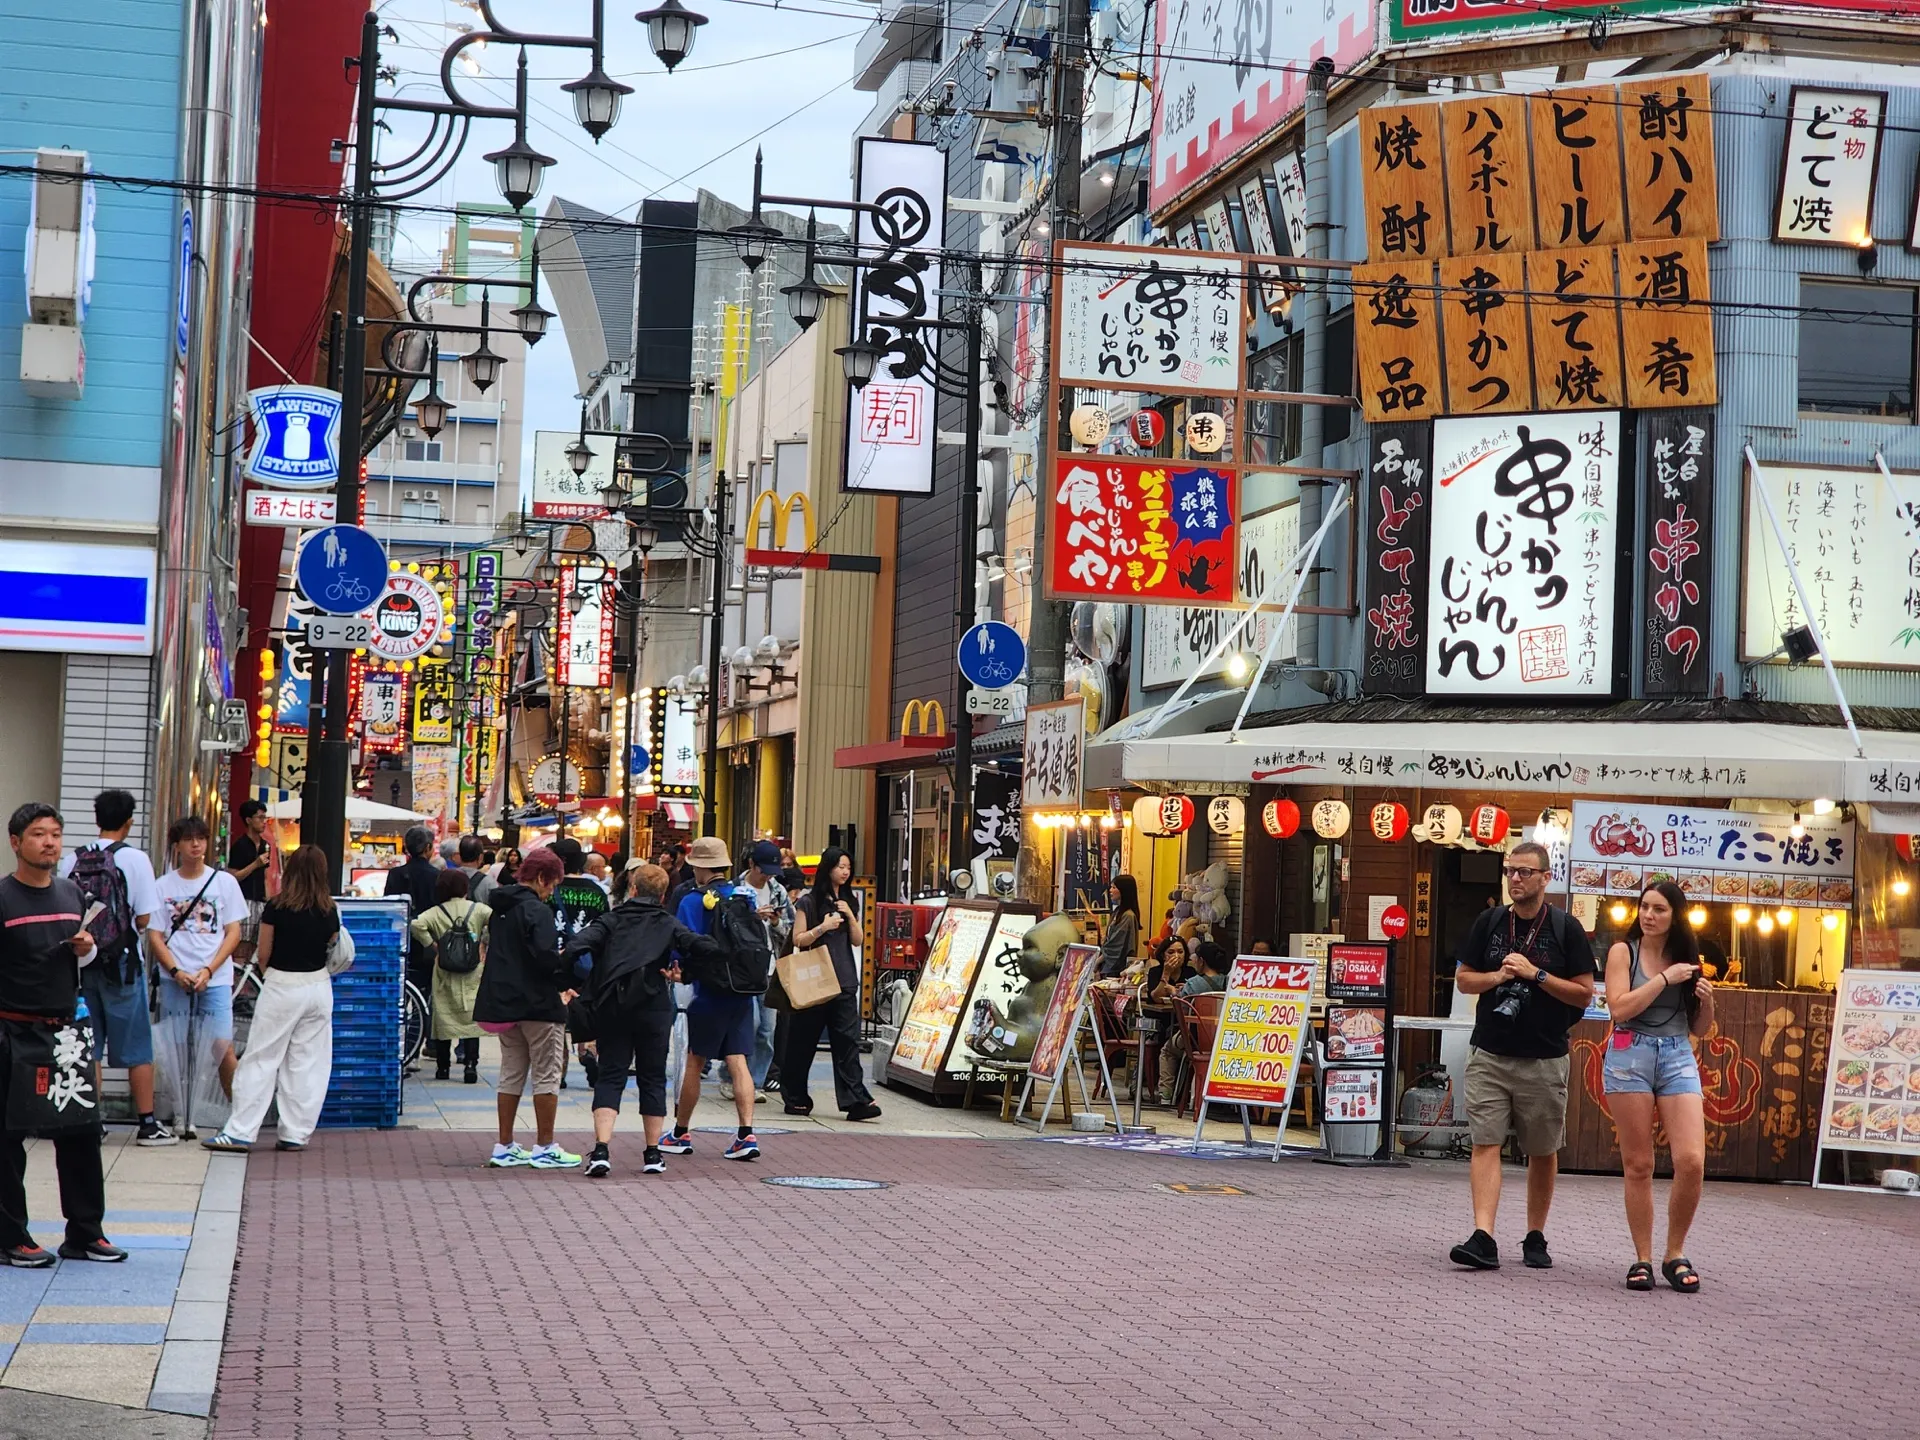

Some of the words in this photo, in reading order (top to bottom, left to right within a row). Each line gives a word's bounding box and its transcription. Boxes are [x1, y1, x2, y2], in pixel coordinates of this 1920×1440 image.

[1843, 107, 1868, 159] 名物
[1374, 115, 1431, 254] 焼酎
[1463, 107, 1513, 251] ハイボール
[1553, 96, 1605, 245] ビール
[1639, 87, 1694, 236] 酎ハイ
[1789, 105, 1844, 233] どて焼
[1123, 301, 1149, 363] じゃん
[1135, 260, 1188, 373] 串かつ
[1207, 267, 1235, 354] 味自慢
[1552, 259, 1608, 405] どて焼
[1635, 251, 1694, 396] 酒肴
[1098, 313, 1136, 378] じゃん
[1369, 273, 1427, 413] 逸品
[1460, 267, 1511, 410] 串かつ
[264, 399, 335, 417] LAWSON
[867, 388, 915, 439] 寿司
[1192, 416, 1217, 448] 串かつ
[261, 458, 330, 473] STATION
[1373, 438, 1424, 487] 名物
[1578, 421, 1613, 508] 味自慢
[1679, 425, 1706, 483] 屋台
[1106, 467, 1137, 557] じゃんじゃん
[1180, 492, 1200, 529] 求ム
[1196, 477, 1218, 529] 挑戦者
[1494, 425, 1574, 610] 串かつ
[1787, 481, 1801, 533] ほたて
[1817, 481, 1836, 518] 海老
[1851, 484, 1867, 565] じゃがいも
[1138, 468, 1170, 588] ゲテモノ
[1818, 528, 1835, 556] いか
[1127, 560, 1145, 592] 串も
[1368, 485, 1423, 651] どて焼
[1476, 510, 1518, 635] じゃん
[1650, 504, 1701, 675] 串かつ
[380, 614, 419, 632] KING
[1437, 555, 1506, 681] じゃん
[1848, 576, 1865, 629] 玉ねぎ
[313, 625, 368, 642] 9-22
[377, 637, 420, 654] OSAKA
[1646, 614, 1667, 684] 味自慢
[377, 684, 394, 723] 串カツ
[969, 696, 1010, 711] 9-22
[1024, 733, 1078, 799] 半弓道場
[1338, 753, 1394, 777] 味自慢
[1163, 797, 1182, 829] ホルモン
[1213, 800, 1230, 831] 豚バラ
[1375, 804, 1395, 837] ホルモン
[1429, 808, 1446, 840] 豚バラ
[1666, 813, 1707, 828] 日本一
[1717, 819, 1752, 828] TAKOYAKI
[1717, 829, 1844, 867] たこ焼き
[1416, 881, 1429, 931] 営業中
[1231, 965, 1315, 989] タイムサービス
[1348, 964, 1377, 973] OSAKA
[1227, 1001, 1266, 1023] 生ビール
[1887, 990, 1920, 1008] たこ
[1221, 1029, 1262, 1053] 酎ハイ
[1214, 1058, 1254, 1079] ハイボール
[1760, 1006, 1806, 1163] たこ焼き
